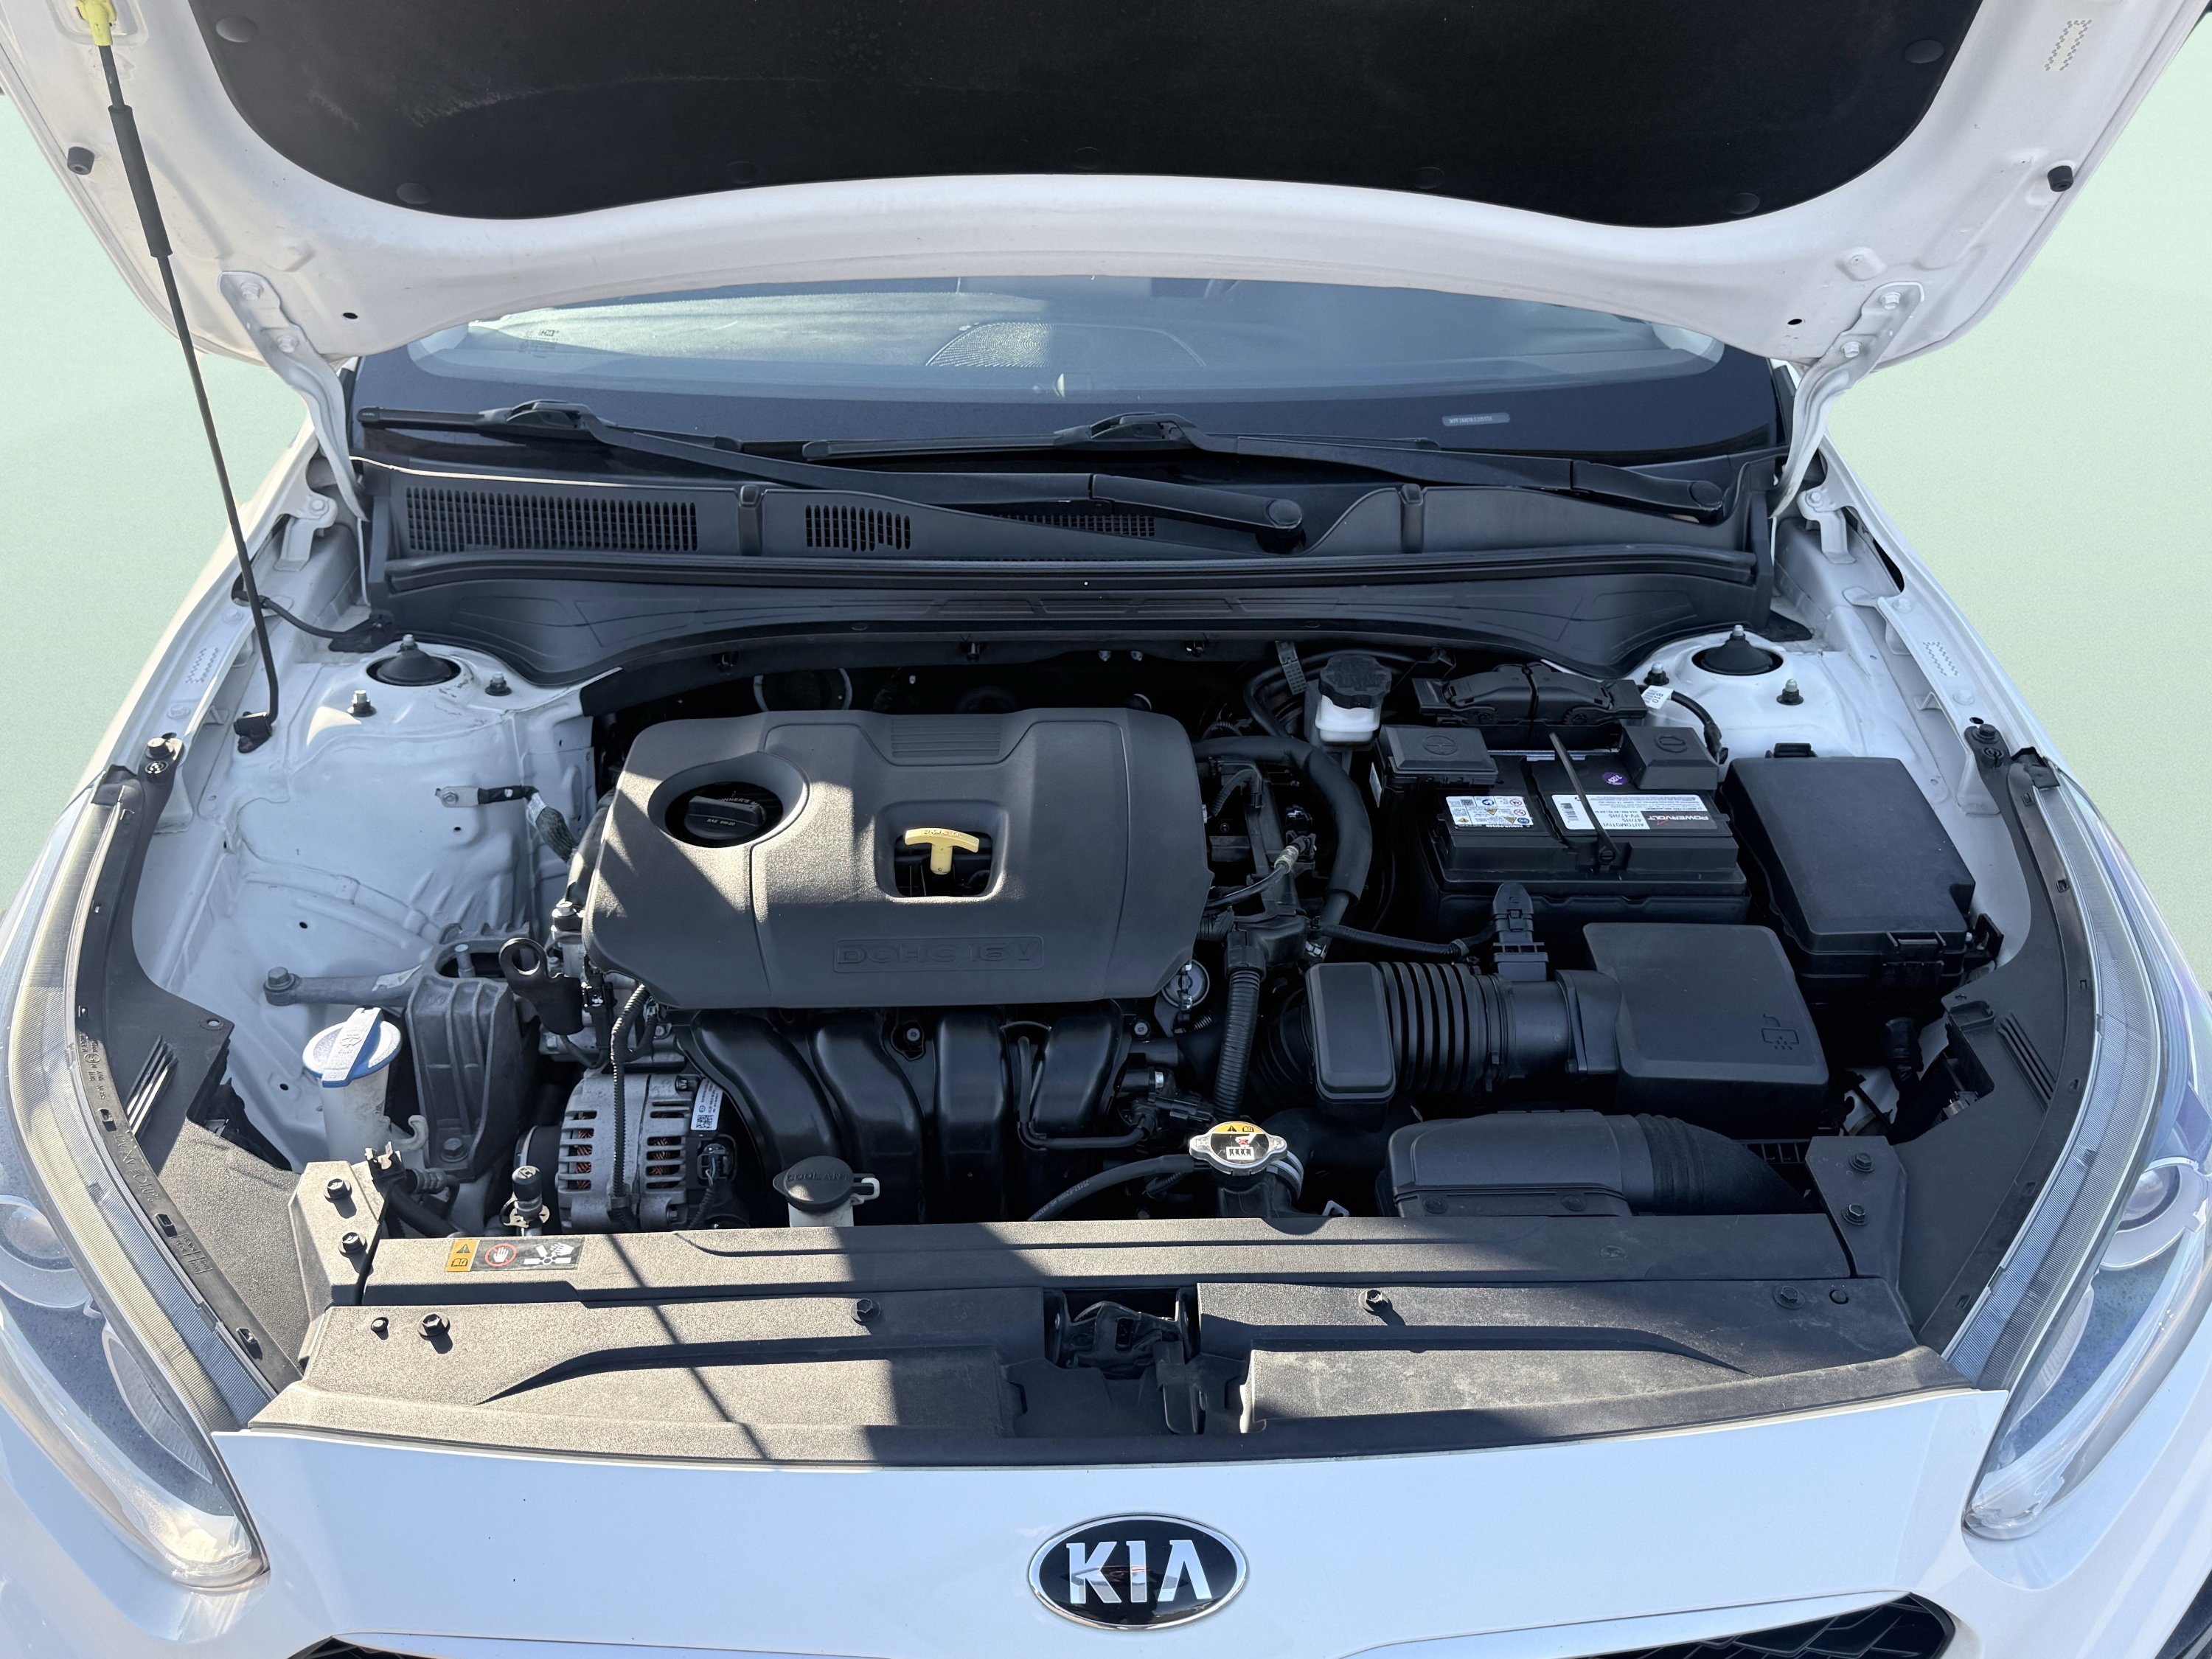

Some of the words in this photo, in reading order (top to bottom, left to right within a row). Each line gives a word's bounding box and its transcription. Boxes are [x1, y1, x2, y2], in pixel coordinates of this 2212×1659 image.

[837, 944, 957, 964] DOHC
[968, 942, 1040, 962] 16V
[787, 1172, 850, 1182] COOLANT
[1065, 1539, 1212, 1604] KIA
